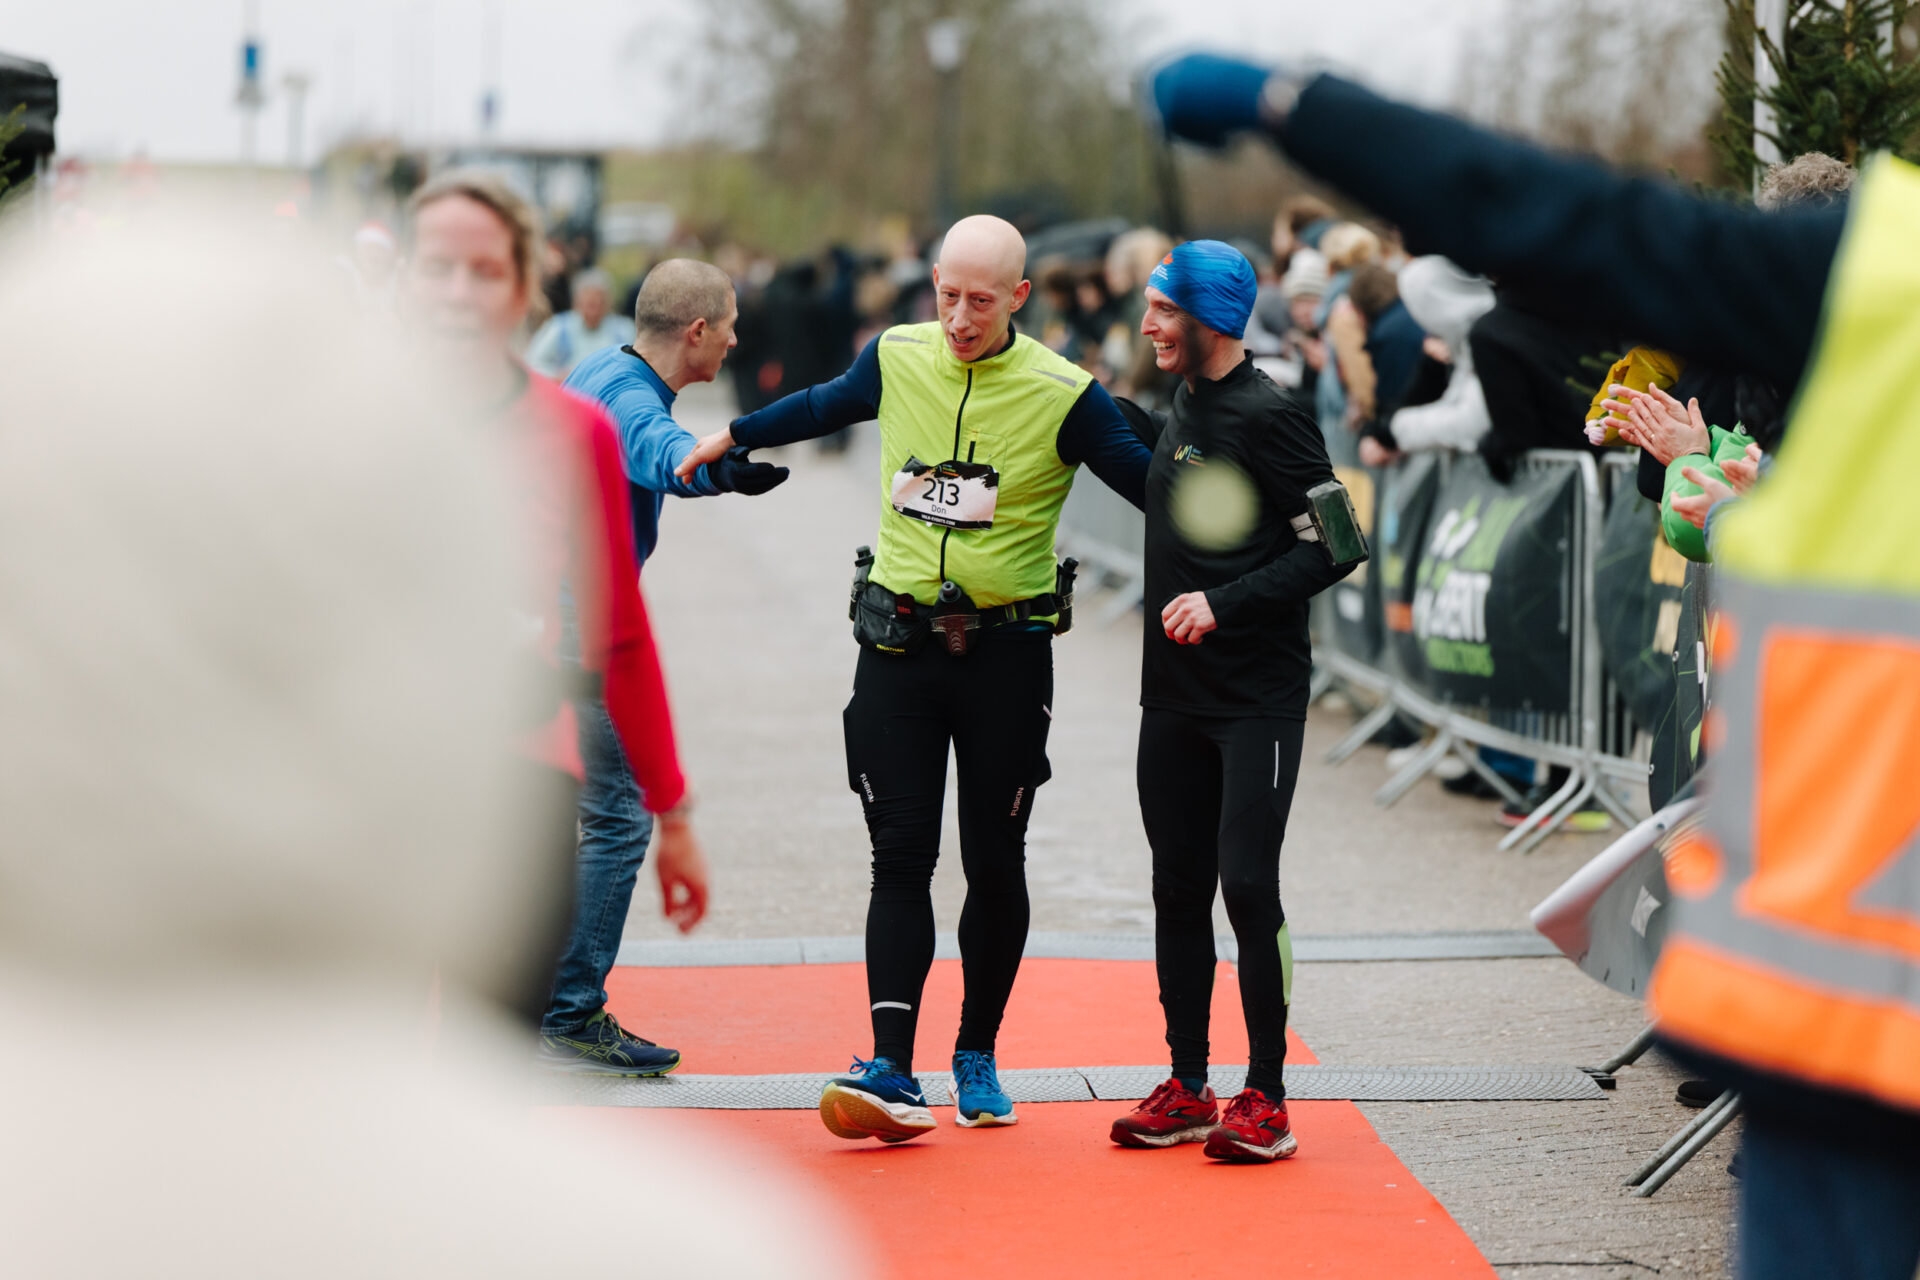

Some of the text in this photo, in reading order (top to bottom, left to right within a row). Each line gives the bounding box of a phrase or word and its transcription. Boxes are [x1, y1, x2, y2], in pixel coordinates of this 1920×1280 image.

[922, 477, 960, 506] 213
[931, 504, 947, 515] Don
[860, 772, 875, 803] FUSION
[1010, 787, 1024, 817] FUSION
